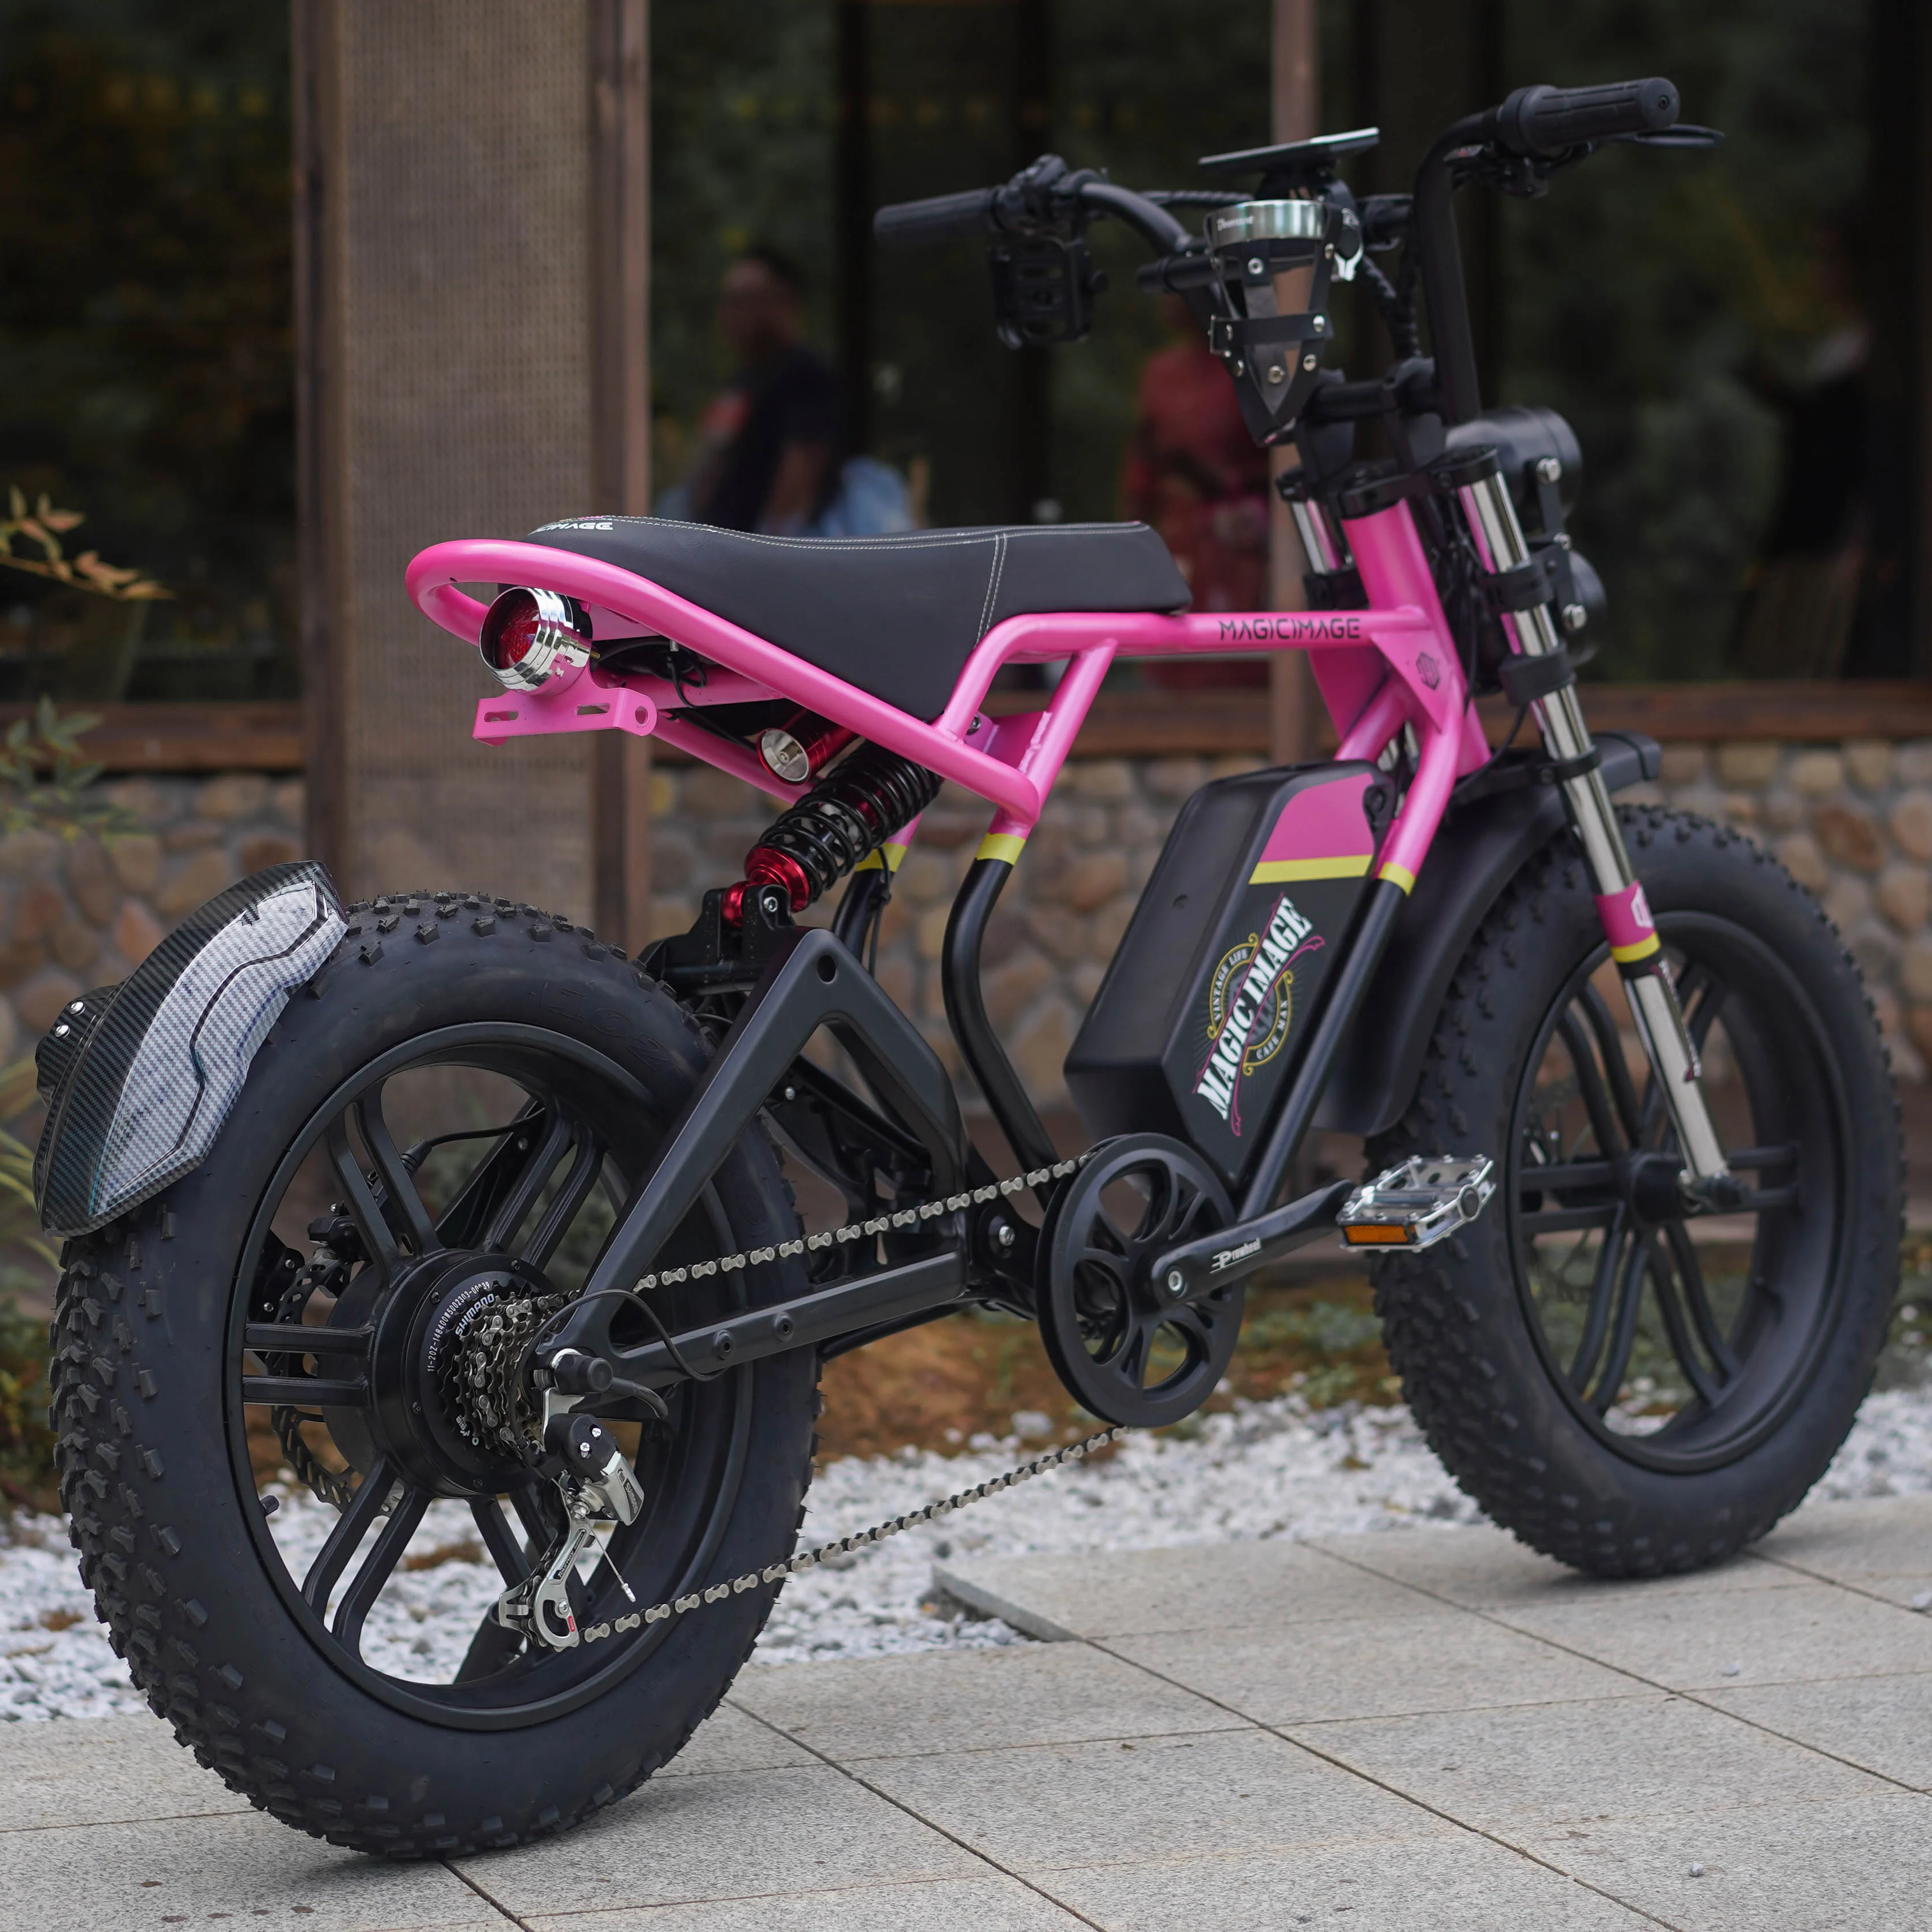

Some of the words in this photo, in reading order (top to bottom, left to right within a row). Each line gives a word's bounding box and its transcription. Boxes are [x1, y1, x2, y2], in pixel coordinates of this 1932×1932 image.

[1218, 619, 1360, 640] MAGICIMAGE
[1197, 997, 1254, 1121] MAGIC
[1242, 896, 1313, 1004] IMAGE
[1213, 963, 1229, 1021] VINTAGE
[1229, 948, 1249, 965] LIFE
[455, 1293, 495, 1336] SHIMANO
